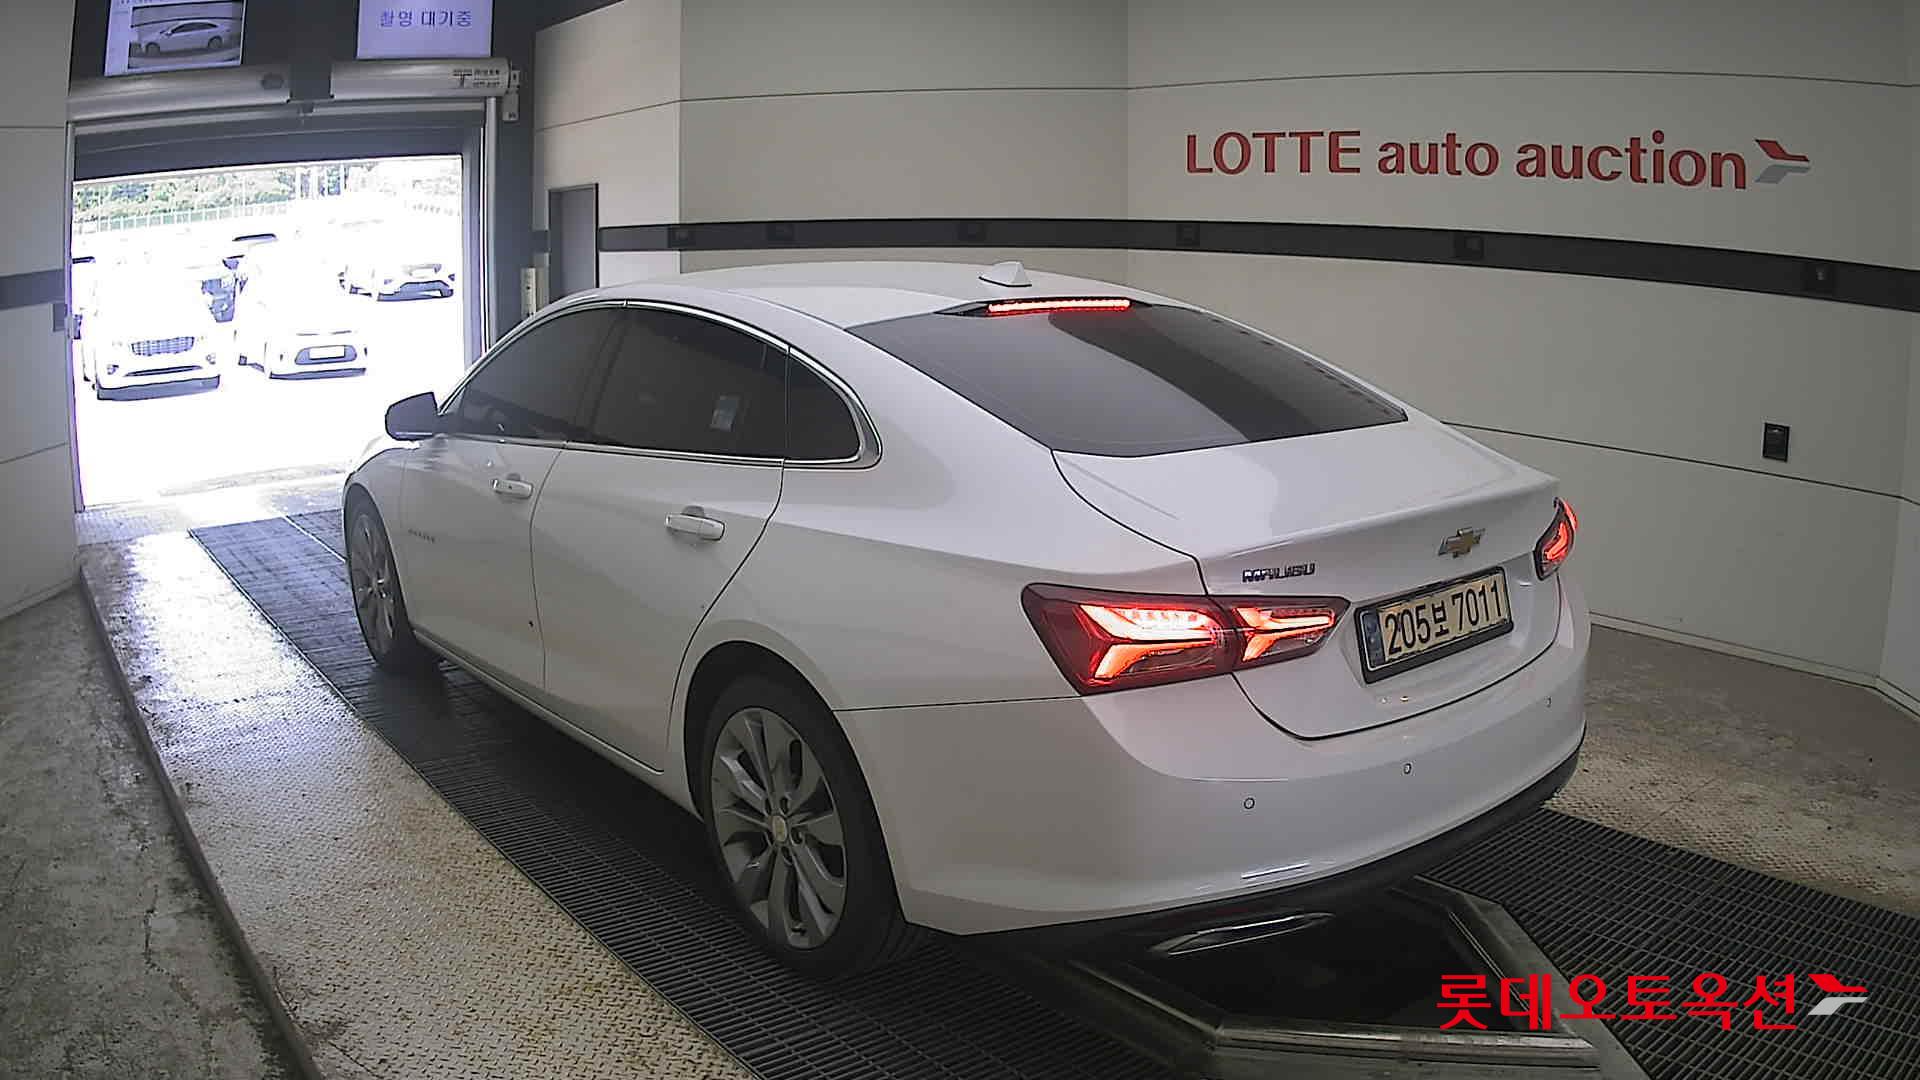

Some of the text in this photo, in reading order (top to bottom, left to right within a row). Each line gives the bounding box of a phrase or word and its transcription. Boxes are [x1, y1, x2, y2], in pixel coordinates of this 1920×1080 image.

[421, 10, 472, 28] 대기중
[1187, 130, 1747, 190] LOTTE auto auction
